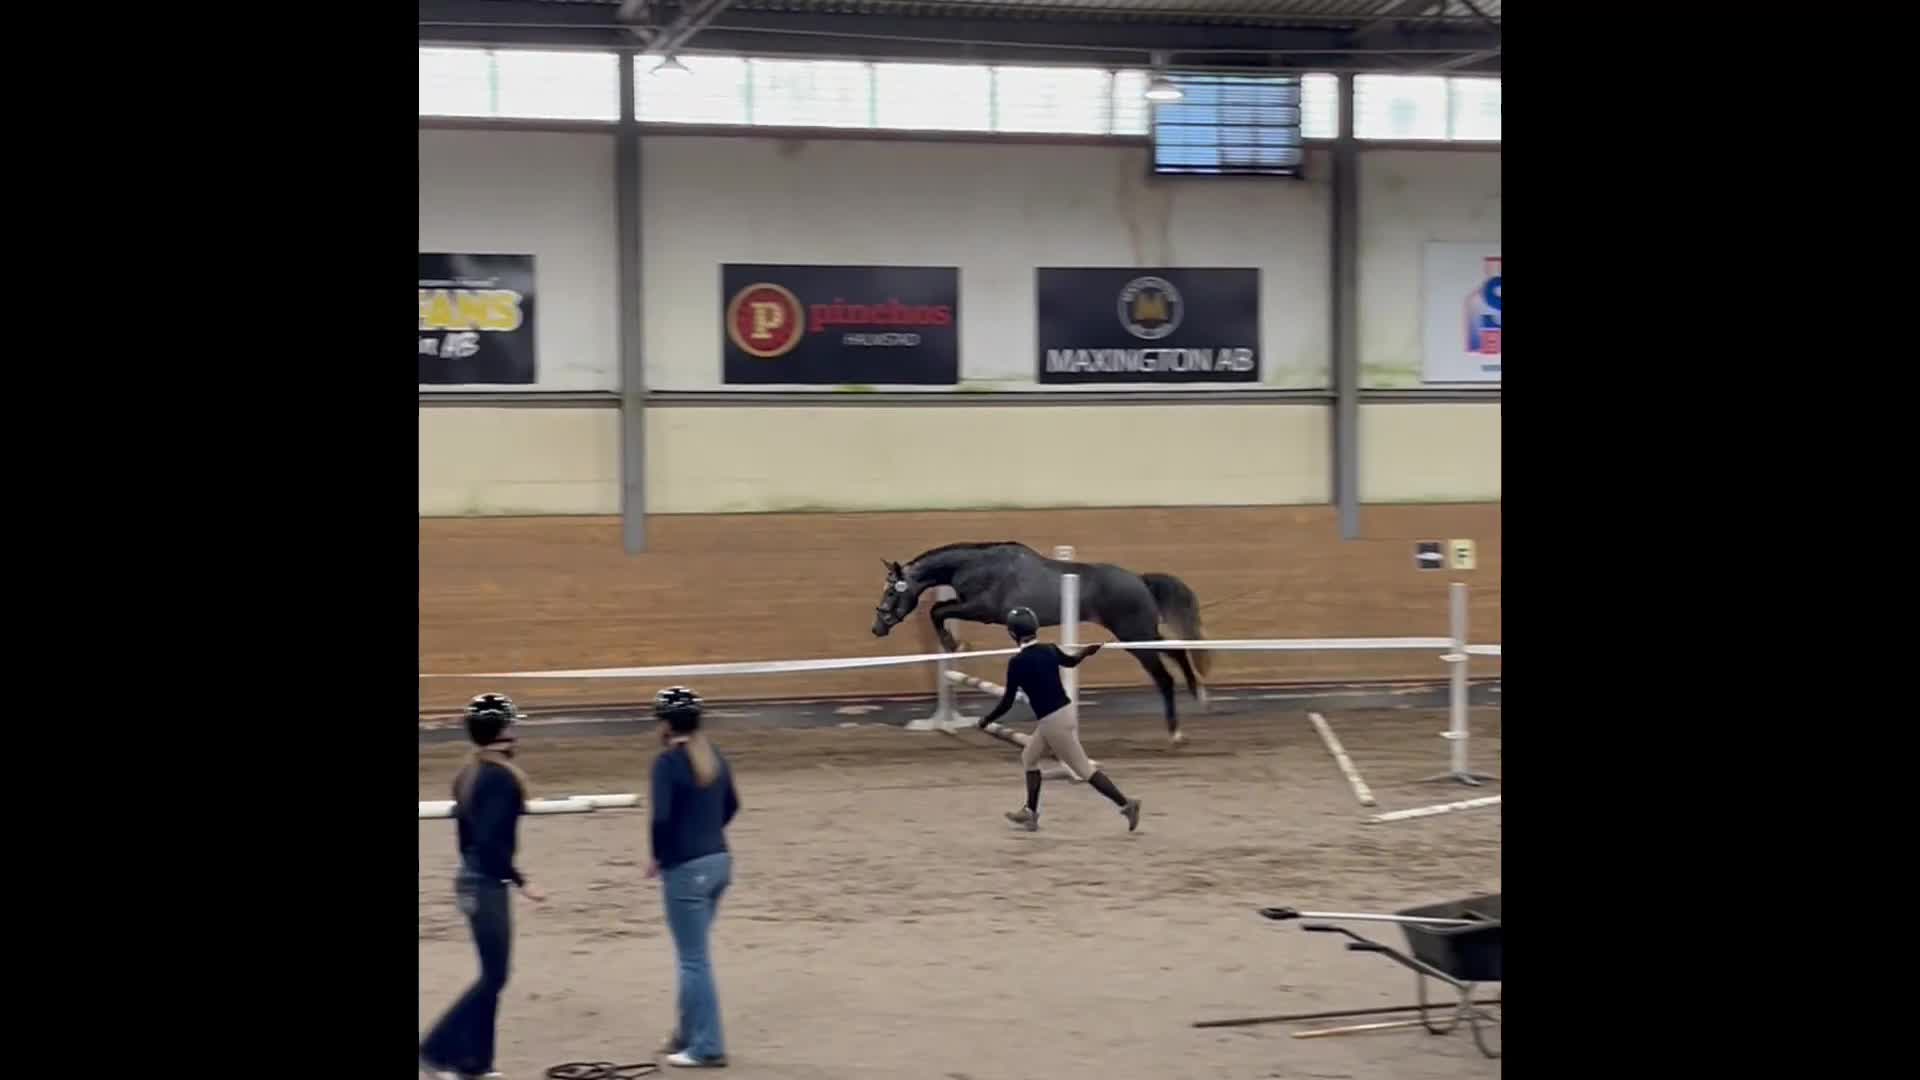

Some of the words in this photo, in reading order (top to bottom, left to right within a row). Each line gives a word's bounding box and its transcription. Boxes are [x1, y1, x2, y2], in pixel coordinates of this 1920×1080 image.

[809, 297, 952, 333] pinchos
[1046, 348, 1213, 372] MAXINGTON
[1214, 348, 1255, 372] AB
